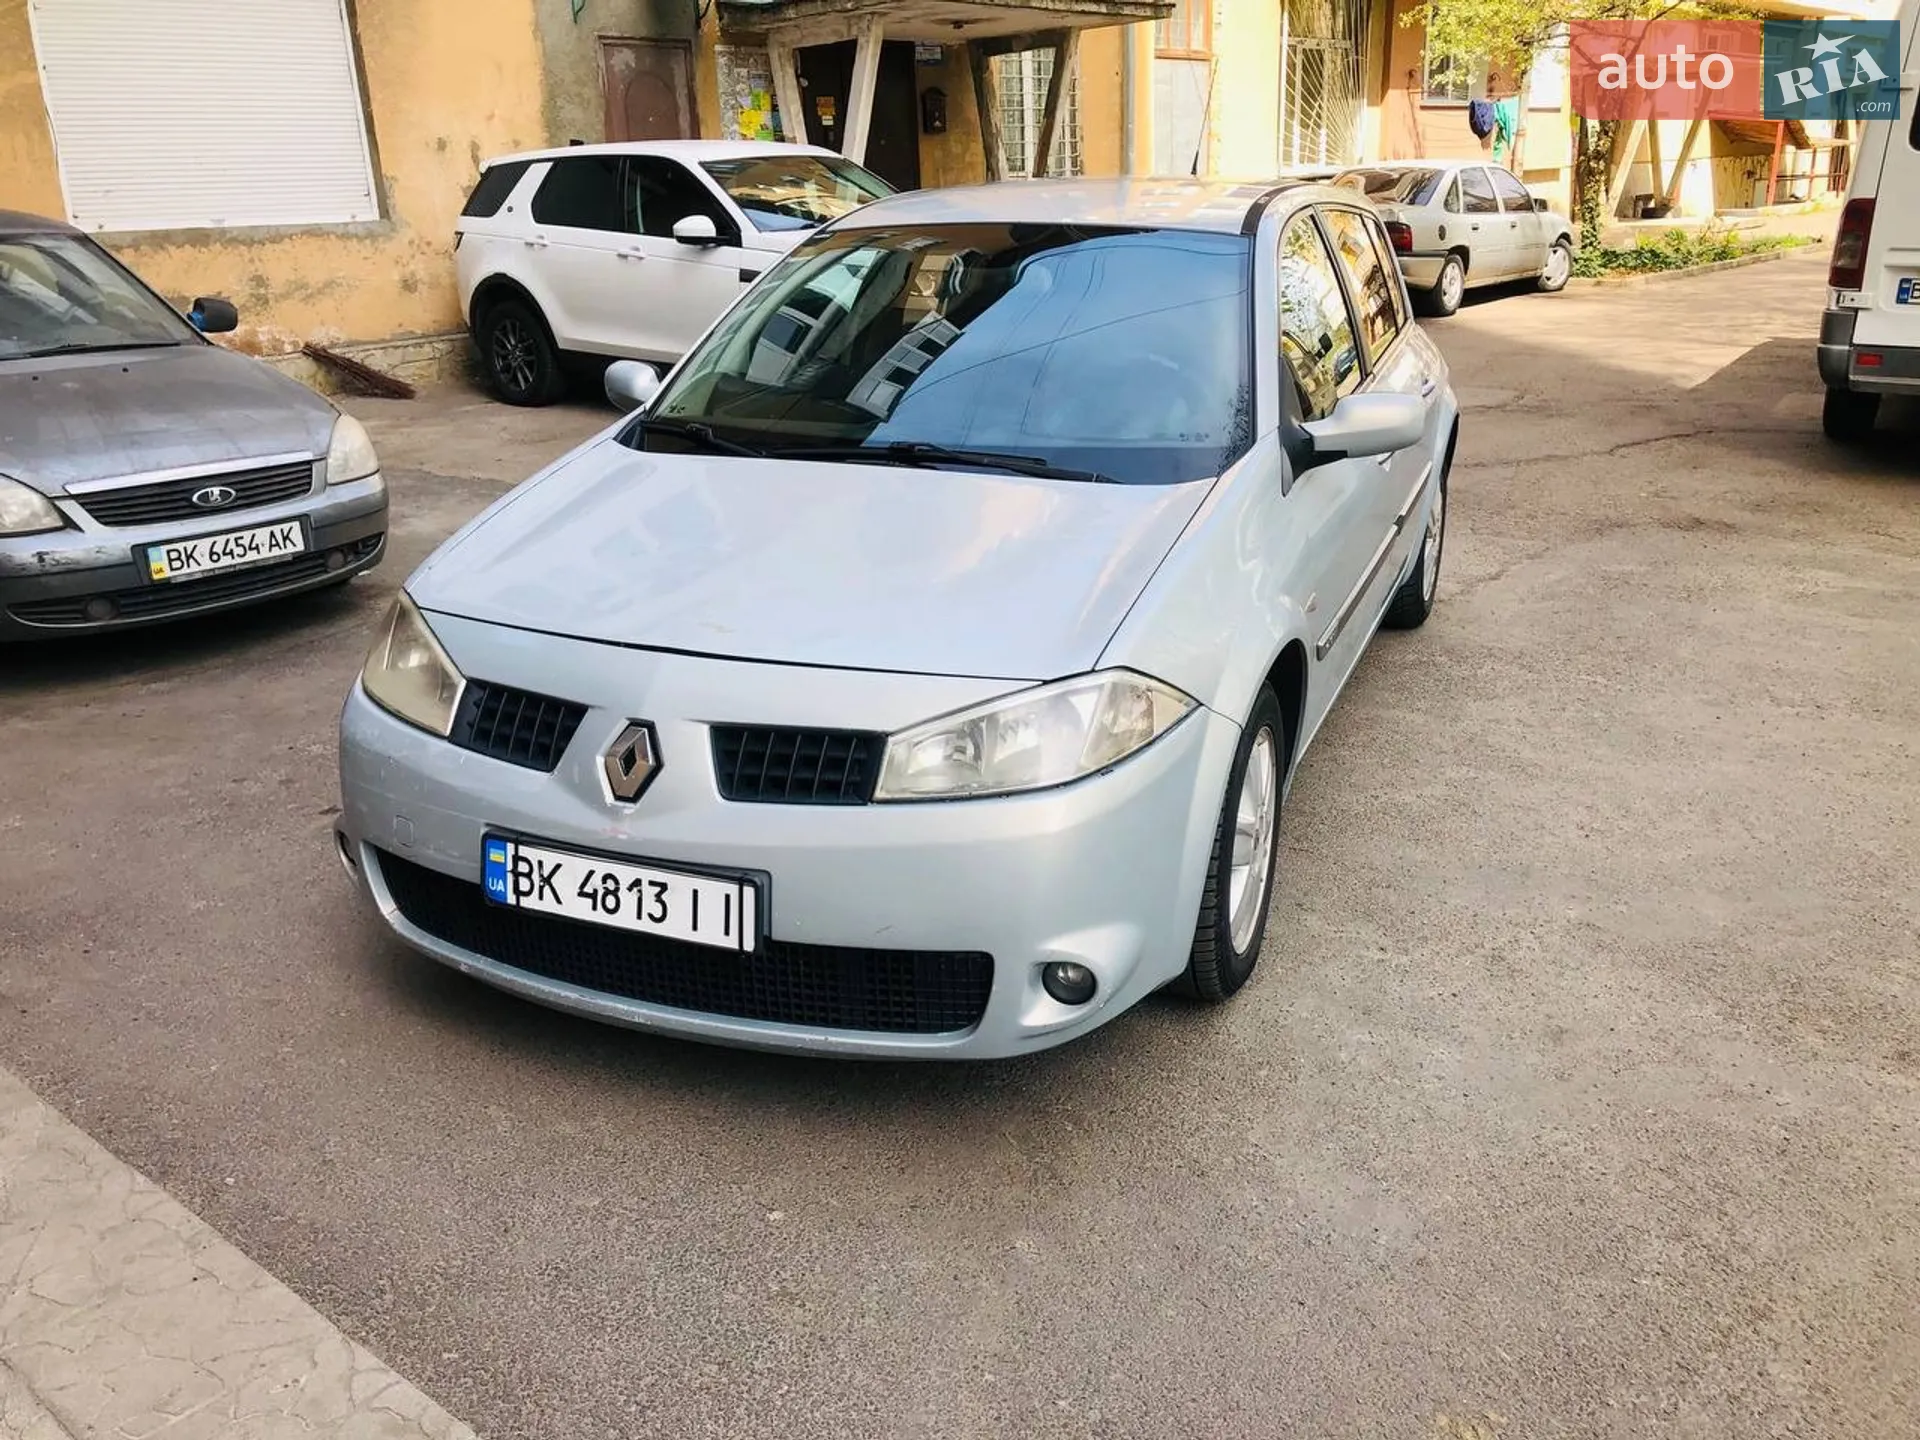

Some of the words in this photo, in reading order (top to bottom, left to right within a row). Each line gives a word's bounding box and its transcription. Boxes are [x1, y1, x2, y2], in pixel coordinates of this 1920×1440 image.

[166, 544, 201, 571] BK
[208, 534, 261, 563] 6454
[268, 526, 296, 552] AK
[488, 878, 505, 893] UA
[510, 855, 563, 905] BK
[577, 869, 668, 924] 4813
